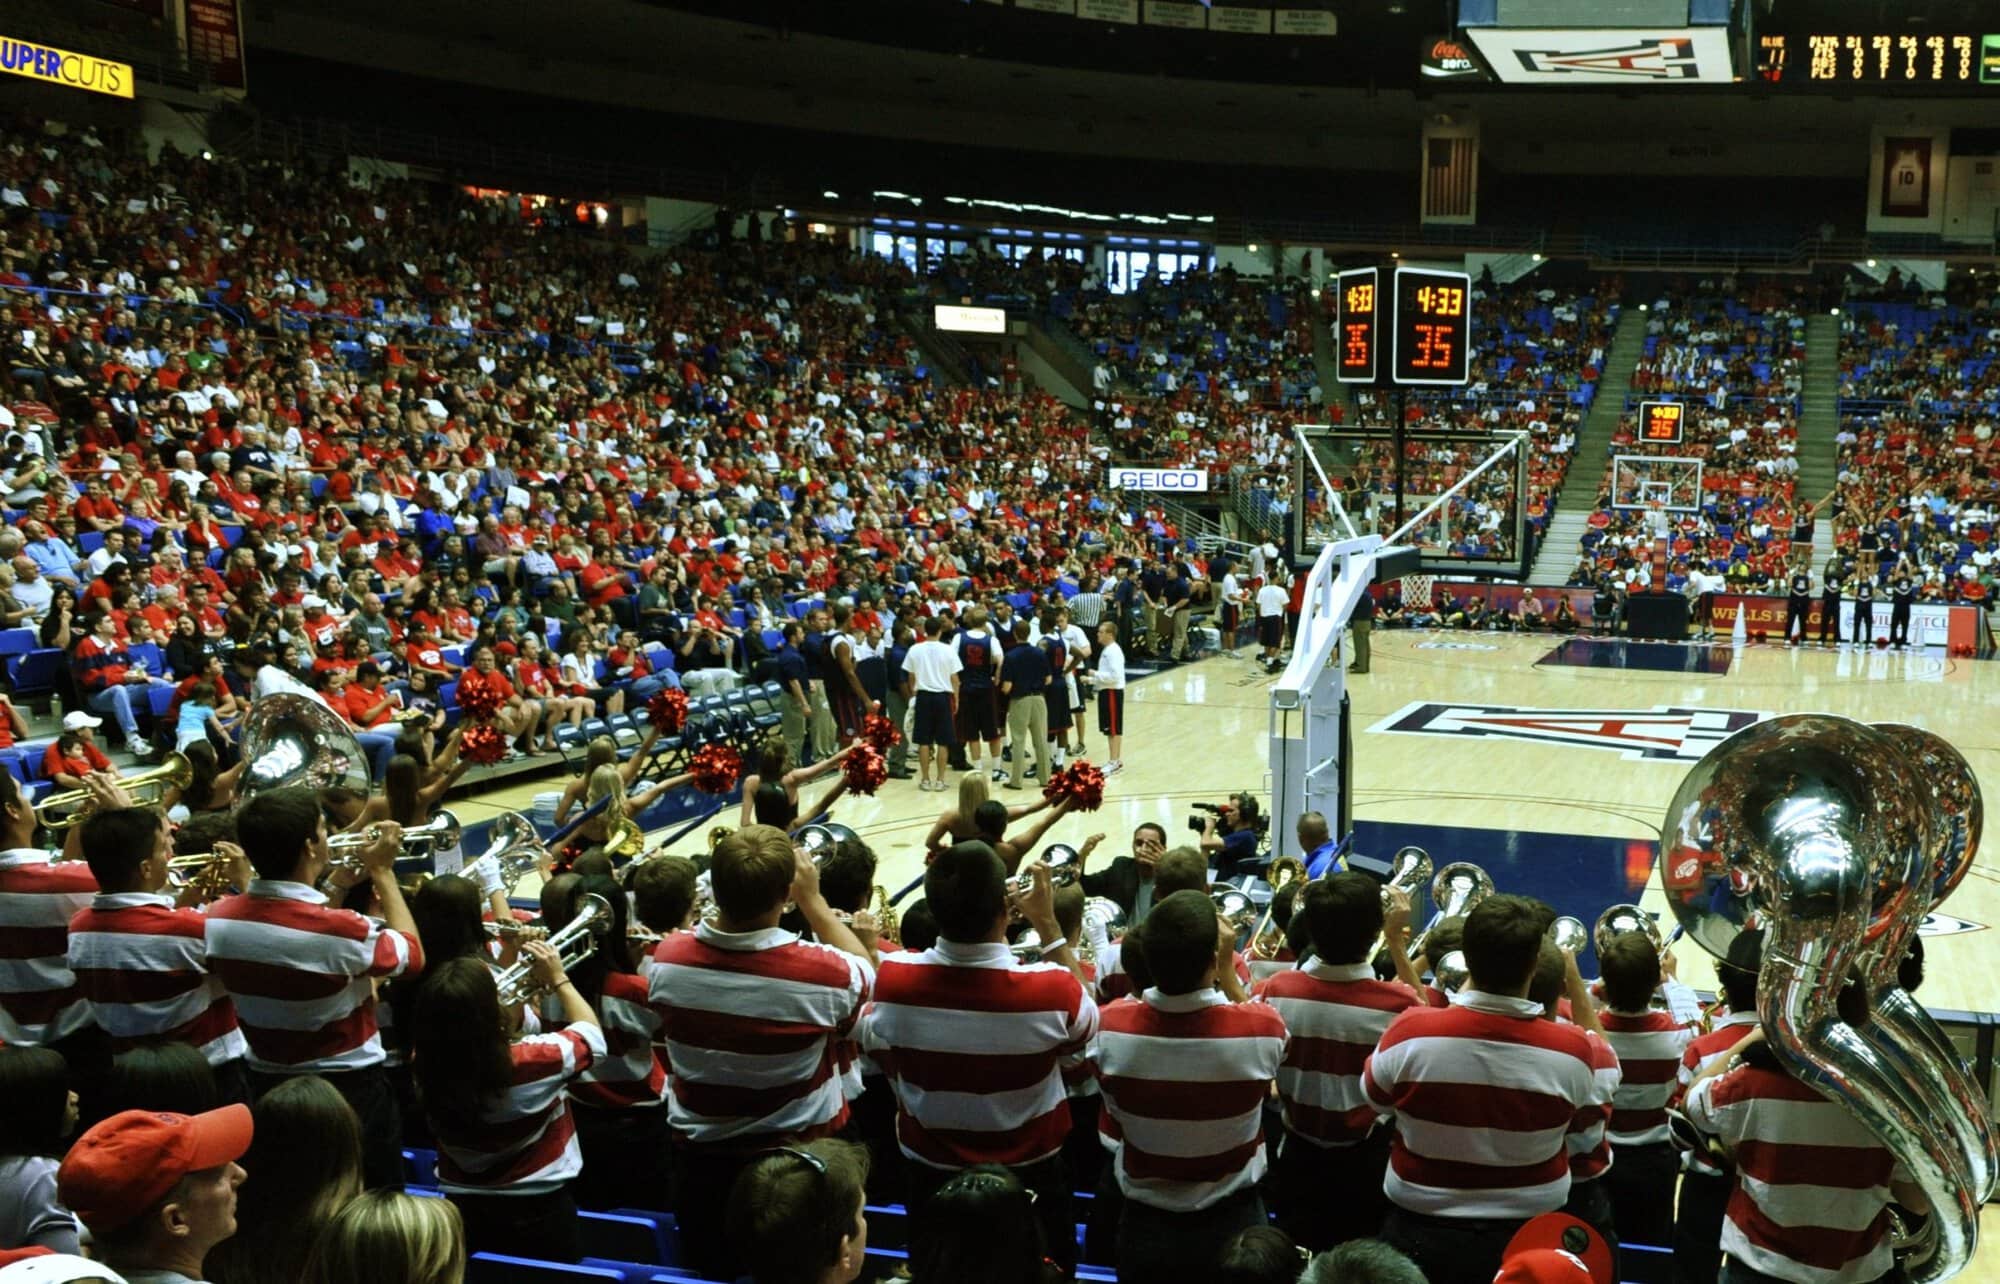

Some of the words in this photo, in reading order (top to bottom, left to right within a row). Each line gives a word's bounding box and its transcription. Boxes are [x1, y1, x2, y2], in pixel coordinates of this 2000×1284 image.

[1, 41, 121, 92] UPERCUTS
[1898, 171, 1915, 185] 10
[1347, 285, 1373, 312] 4:33
[1417, 286, 1463, 315] 4:33
[1411, 324, 1453, 367] 35
[1648, 420, 1674, 437] 35
[1119, 471, 1198, 488] GEICO
[1712, 608, 1772, 622] WELS
